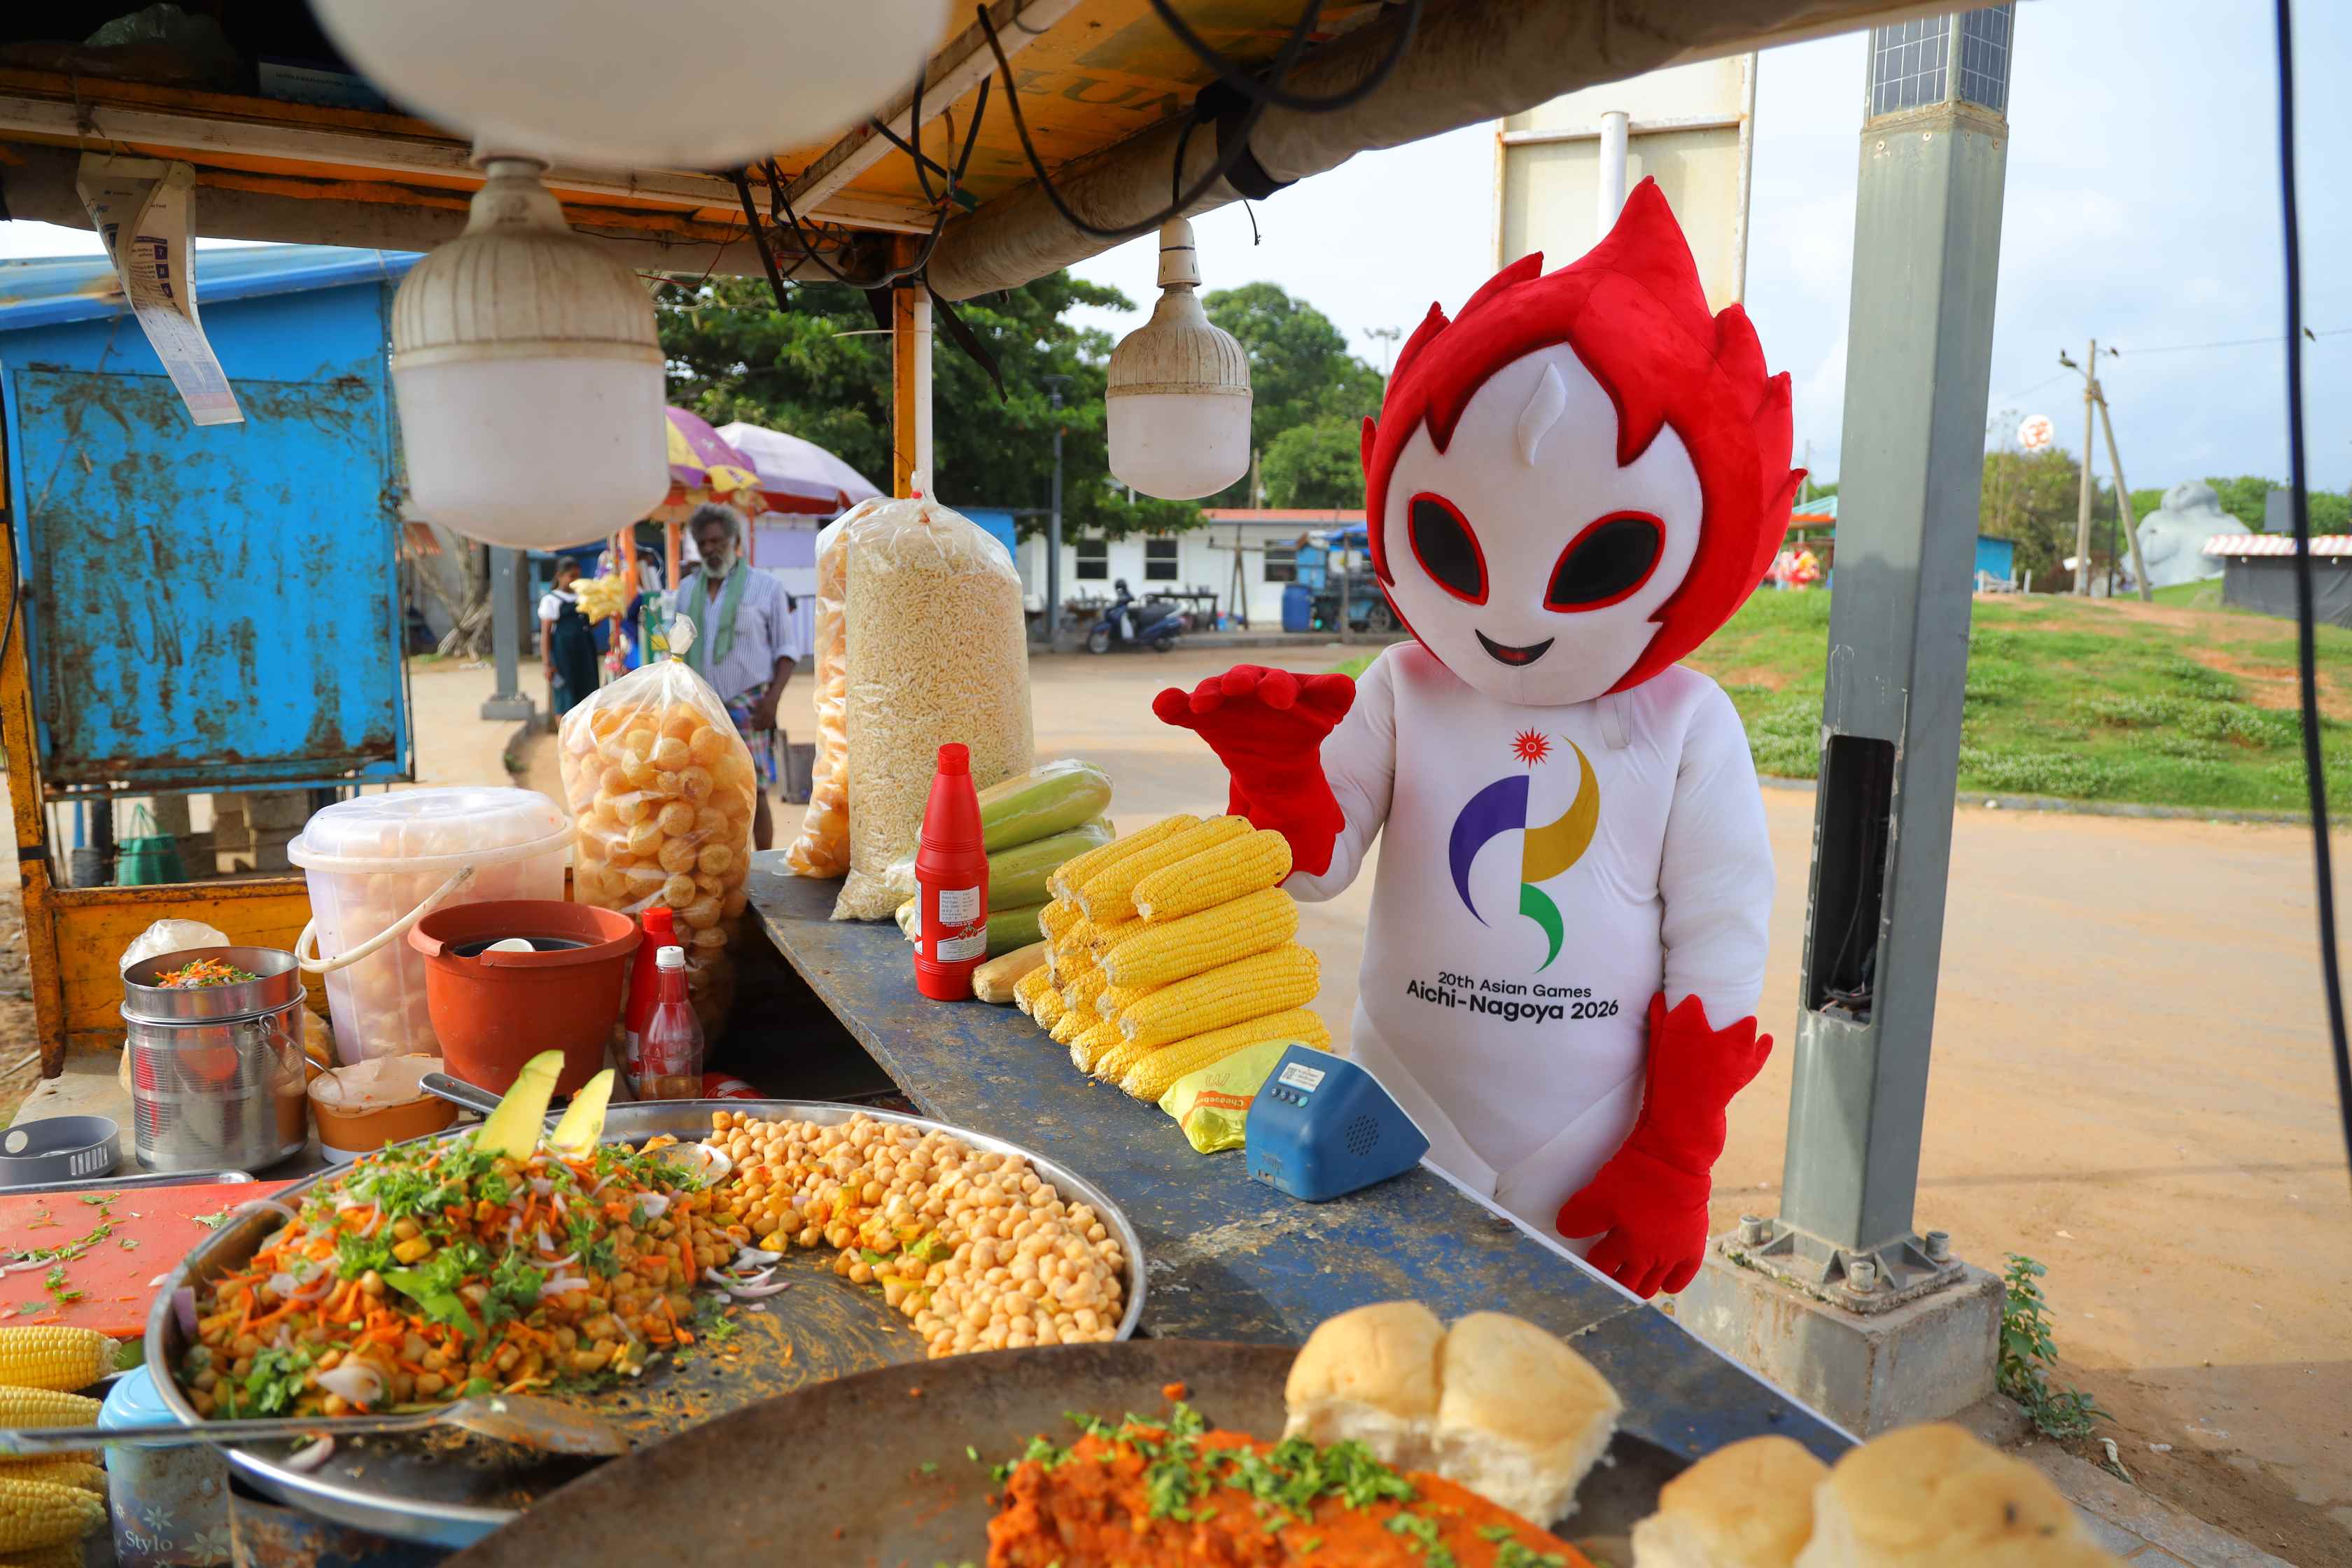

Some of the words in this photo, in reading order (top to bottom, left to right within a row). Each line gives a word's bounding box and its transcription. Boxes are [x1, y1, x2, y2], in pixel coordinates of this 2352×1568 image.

[1438, 972, 1475, 990] 20th
[1479, 979, 1527, 995] Asian
[1532, 983, 1592, 998] Games
[1406, 979, 1564, 1025] Aichi-Nagoya
[1570, 999, 1619, 1020] 2026
[124, 1530, 174, 1557] Stylo
